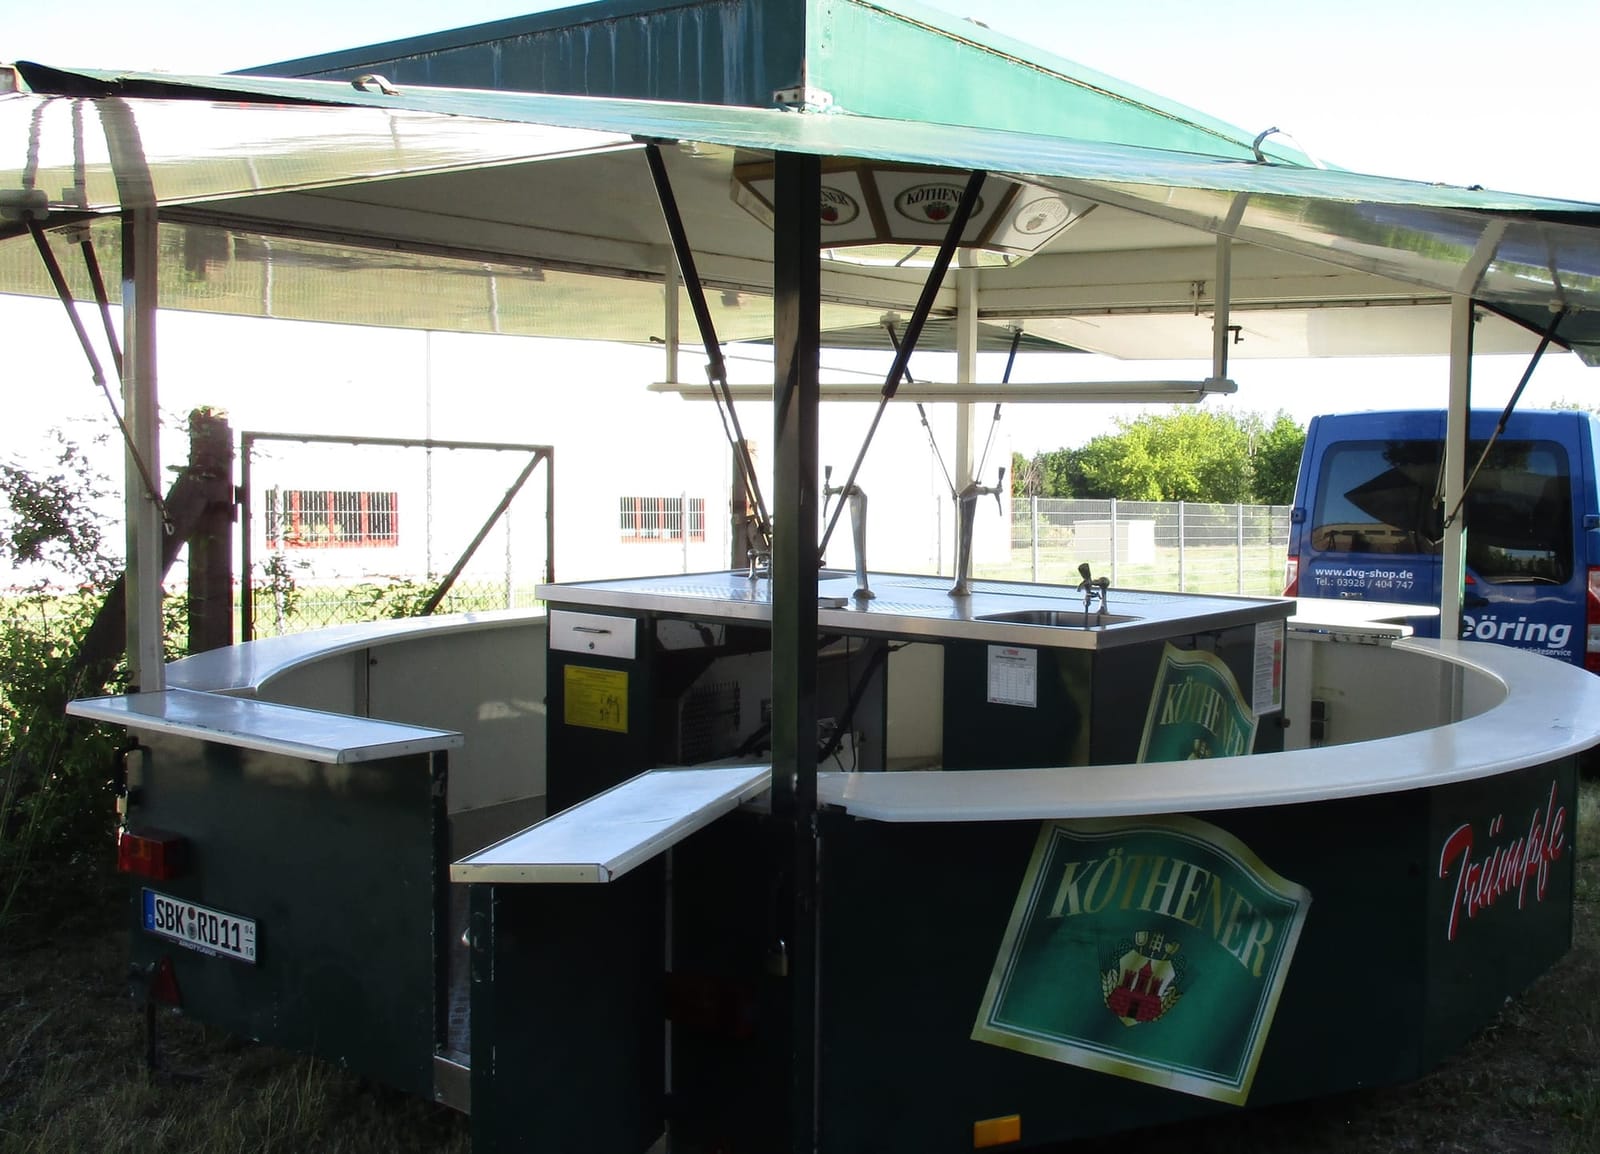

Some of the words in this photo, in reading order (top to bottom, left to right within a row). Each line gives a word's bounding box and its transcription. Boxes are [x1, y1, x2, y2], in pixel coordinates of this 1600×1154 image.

[906, 187, 963, 205] KÖTHEN
[1315, 568, 1413, 579] www.dvg-shop.de
[1315, 578, 1334, 586] Tel.:
[1337, 579, 1365, 587] 03928
[1375, 580, 1392, 588] 404
[1395, 580, 1413, 589] 747
[1439, 779, 1566, 941] Trümpfe
[156, 899, 185, 935] SBK
[197, 911, 242, 953] RD11
[1047, 847, 1274, 977] KÖTHENER
